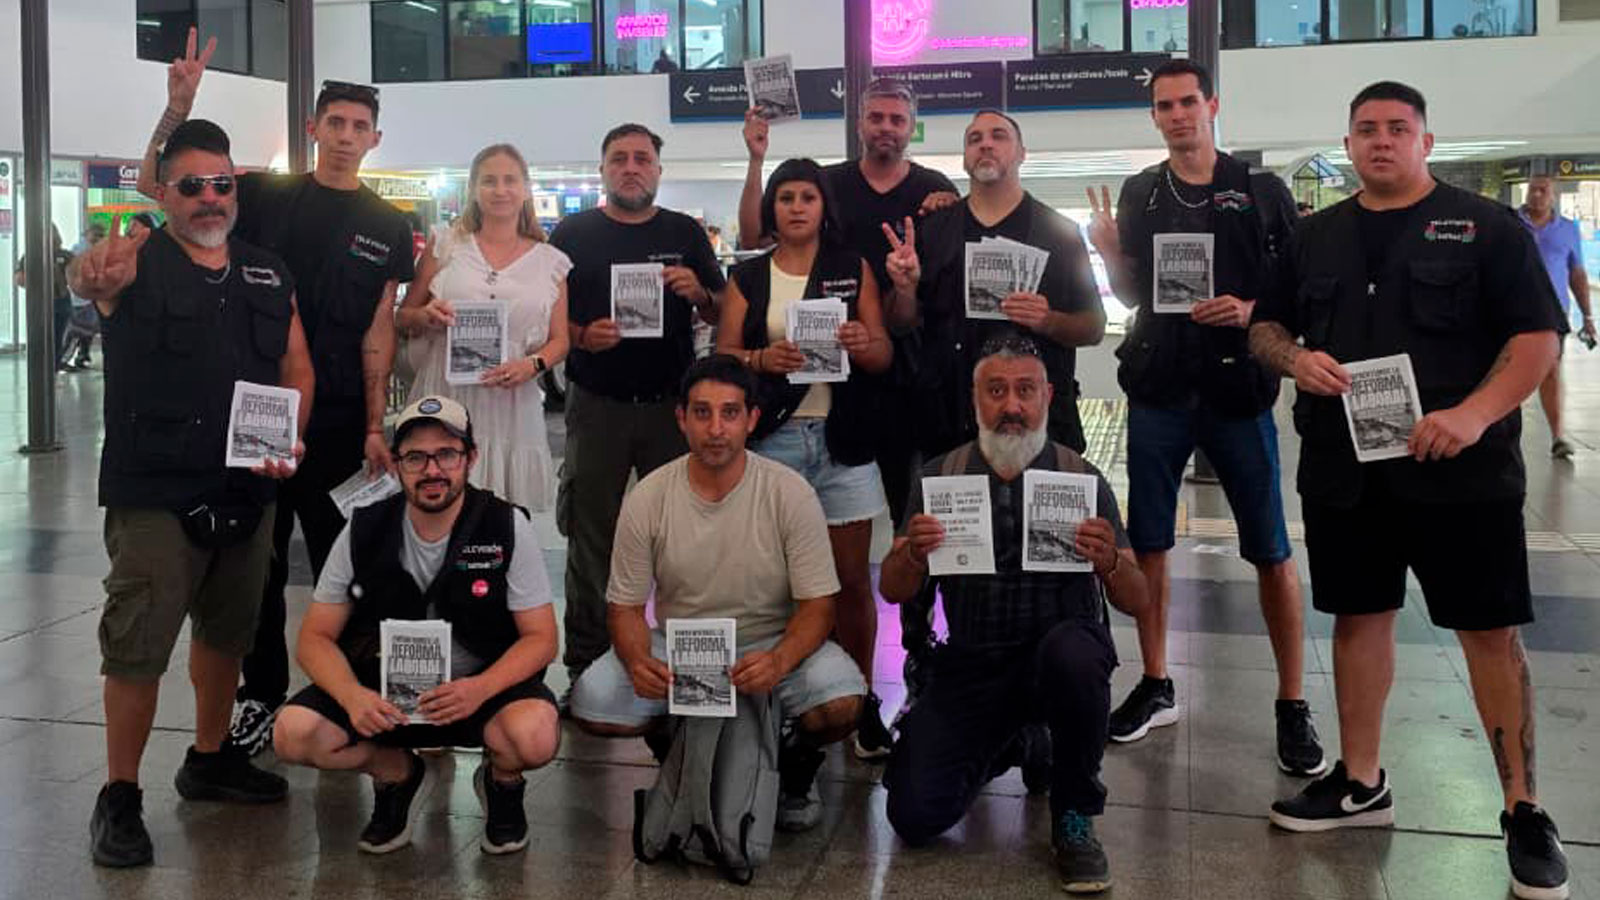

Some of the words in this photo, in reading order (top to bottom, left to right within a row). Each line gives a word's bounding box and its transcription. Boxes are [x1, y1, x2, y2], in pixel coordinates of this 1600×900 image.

[1015, 72, 1048, 81] Paradas
[1160, 260, 1205, 273] LABORAL
[241, 400, 290, 417] REFORMA
[238, 411, 290, 429] LABORAL
[1033, 491, 1087, 509] REFORMA
[391, 643, 442, 660] REFORMA
[674, 636, 727, 652] REFORMA
[389, 657, 441, 674] LABORAL
[674, 650, 727, 666] LABORAL
